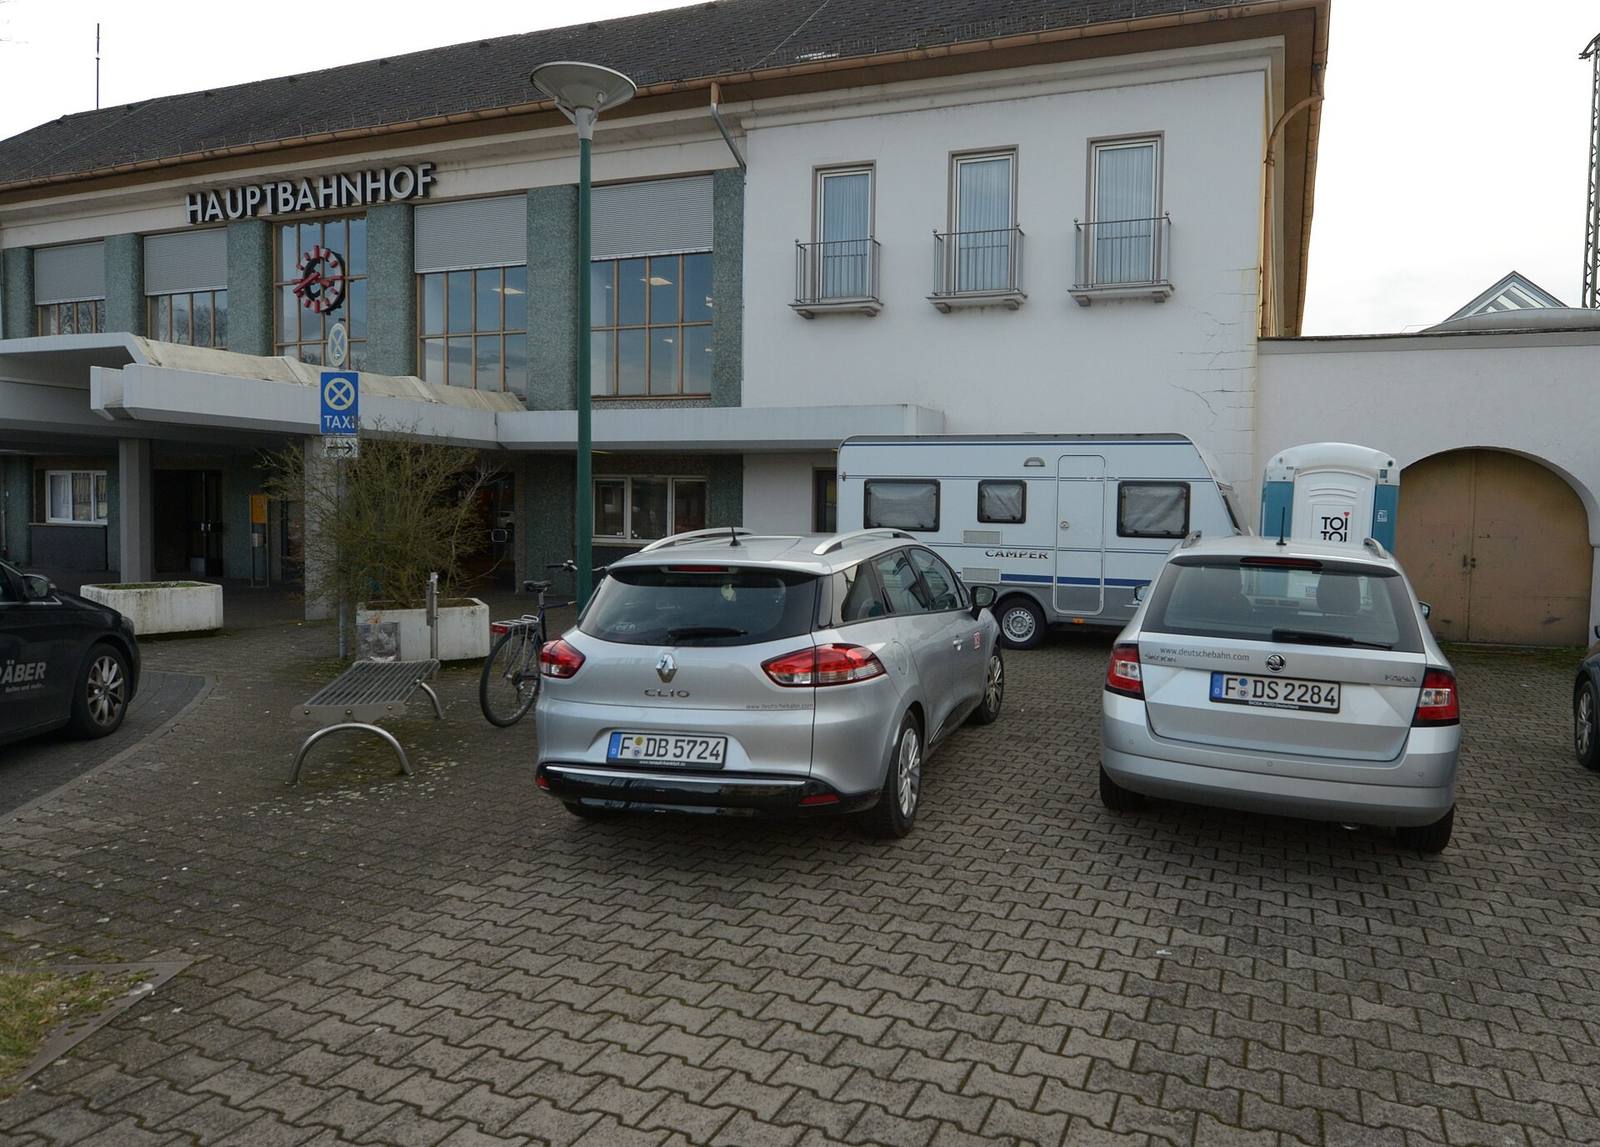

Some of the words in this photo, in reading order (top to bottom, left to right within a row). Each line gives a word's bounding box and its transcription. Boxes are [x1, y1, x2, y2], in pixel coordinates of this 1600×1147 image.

[184, 163, 435, 225] HAUPTBAHNHOF
[1321, 512, 1350, 531] TOI
[985, 550, 1049, 560] CAMPER
[1159, 646, 1250, 662] www.deutschebahn.com
[643, 688, 691, 699] CLIO
[1224, 677, 1239, 697] F
[1252, 679, 1280, 701] DS
[1283, 682, 1337, 707] 2284
[620, 736, 634, 756] F
[643, 737, 670, 758] DB
[673, 738, 722, 761] 5724
